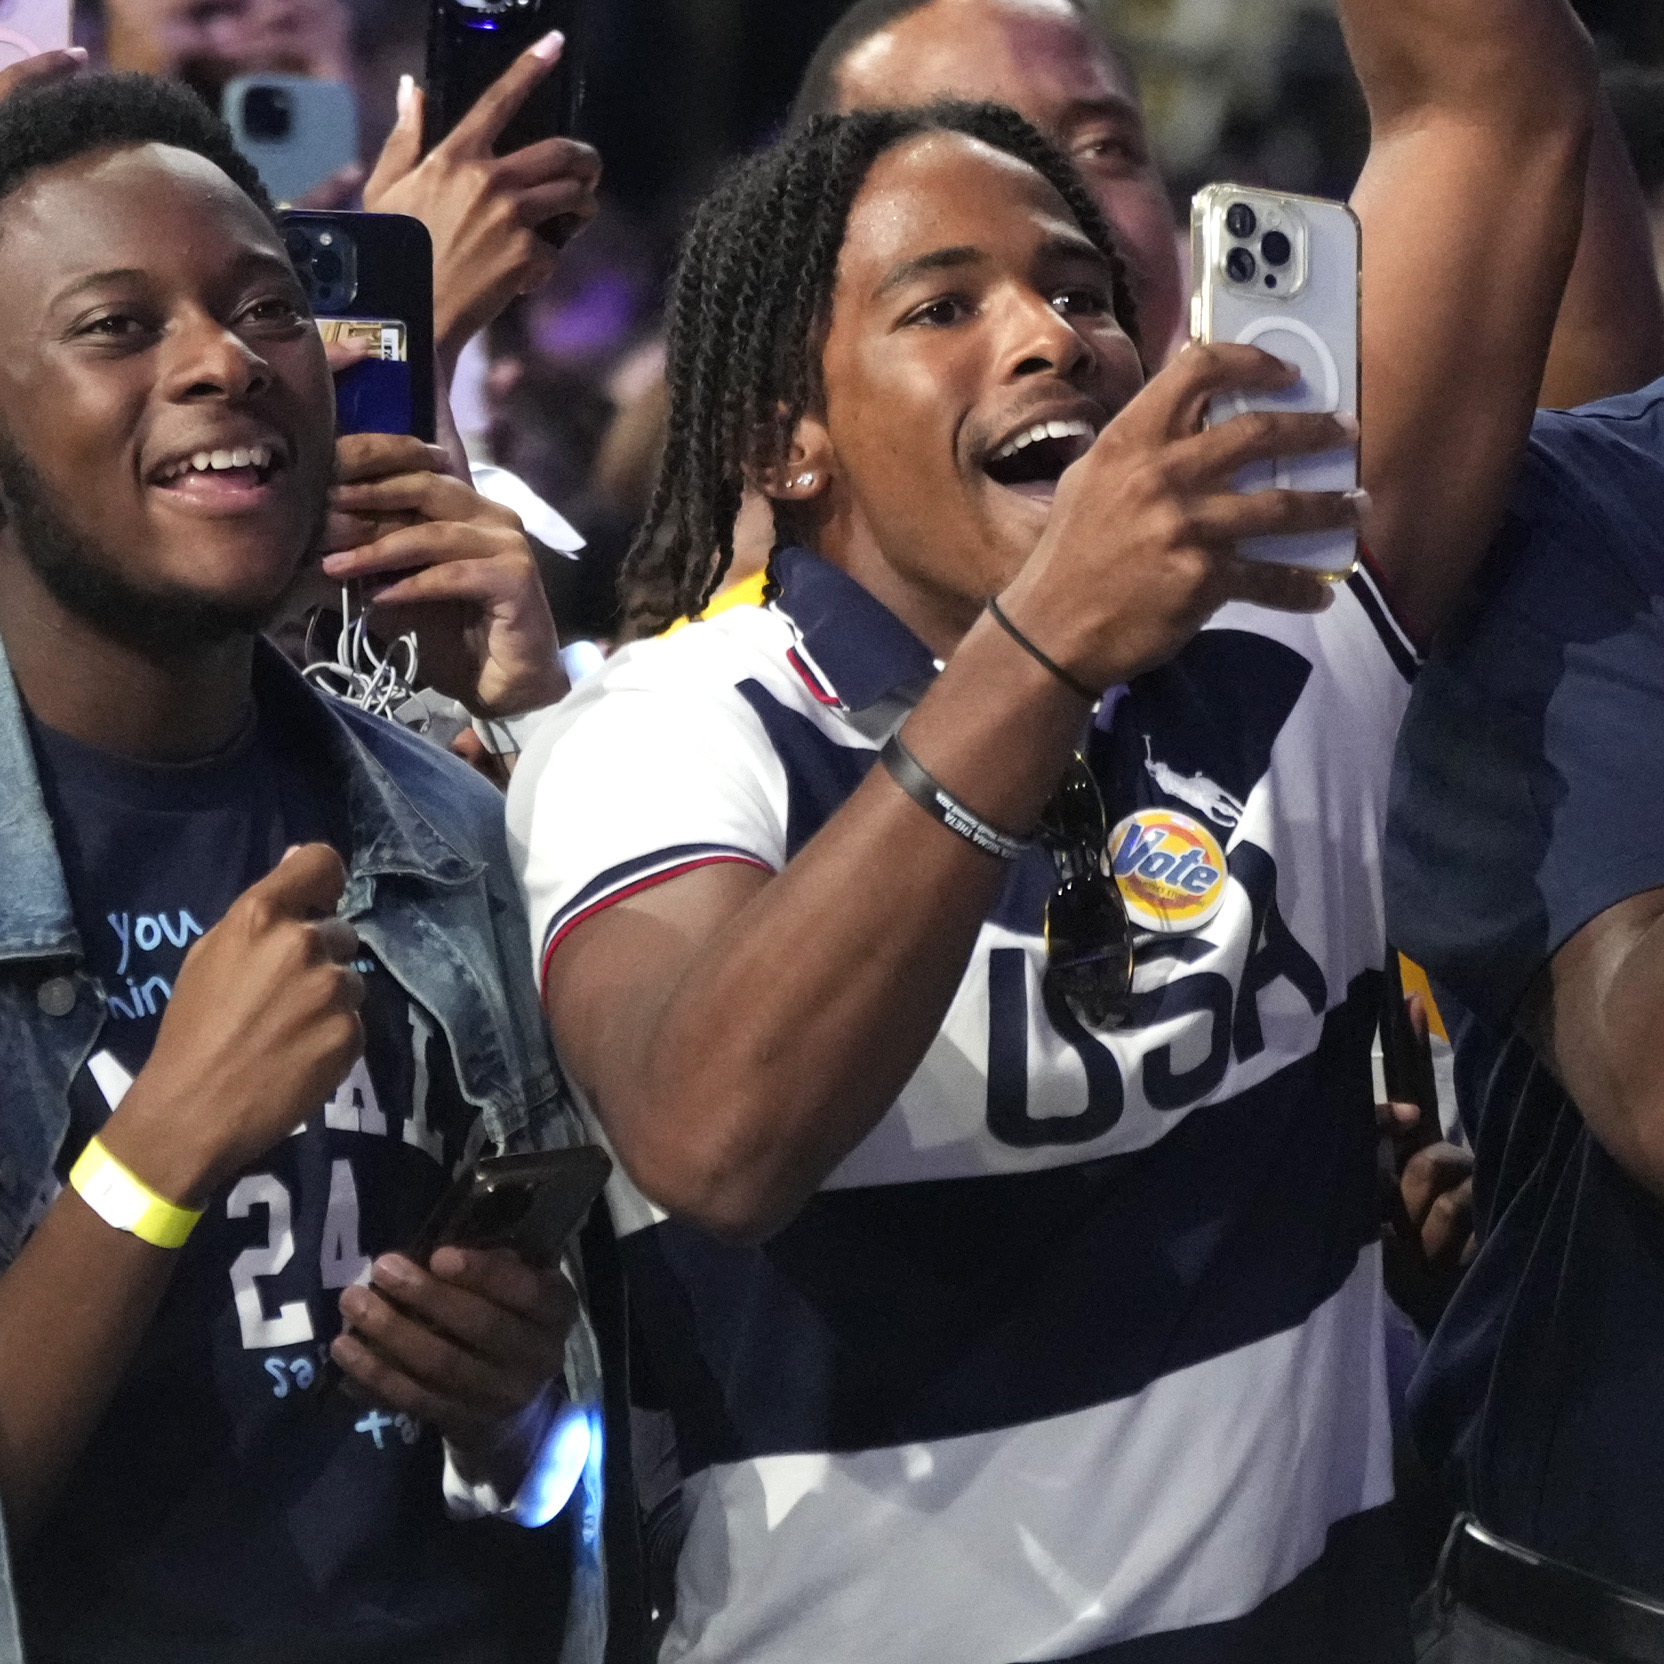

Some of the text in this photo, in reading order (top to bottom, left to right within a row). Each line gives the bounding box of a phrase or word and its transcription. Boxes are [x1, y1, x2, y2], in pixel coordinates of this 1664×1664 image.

[944, 810, 974, 838] THETA
[1113, 822, 1220, 895] Vote
[108, 910, 204, 976] you
[985, 838, 1329, 1149] USA
[226, 1158, 374, 1350] 24
